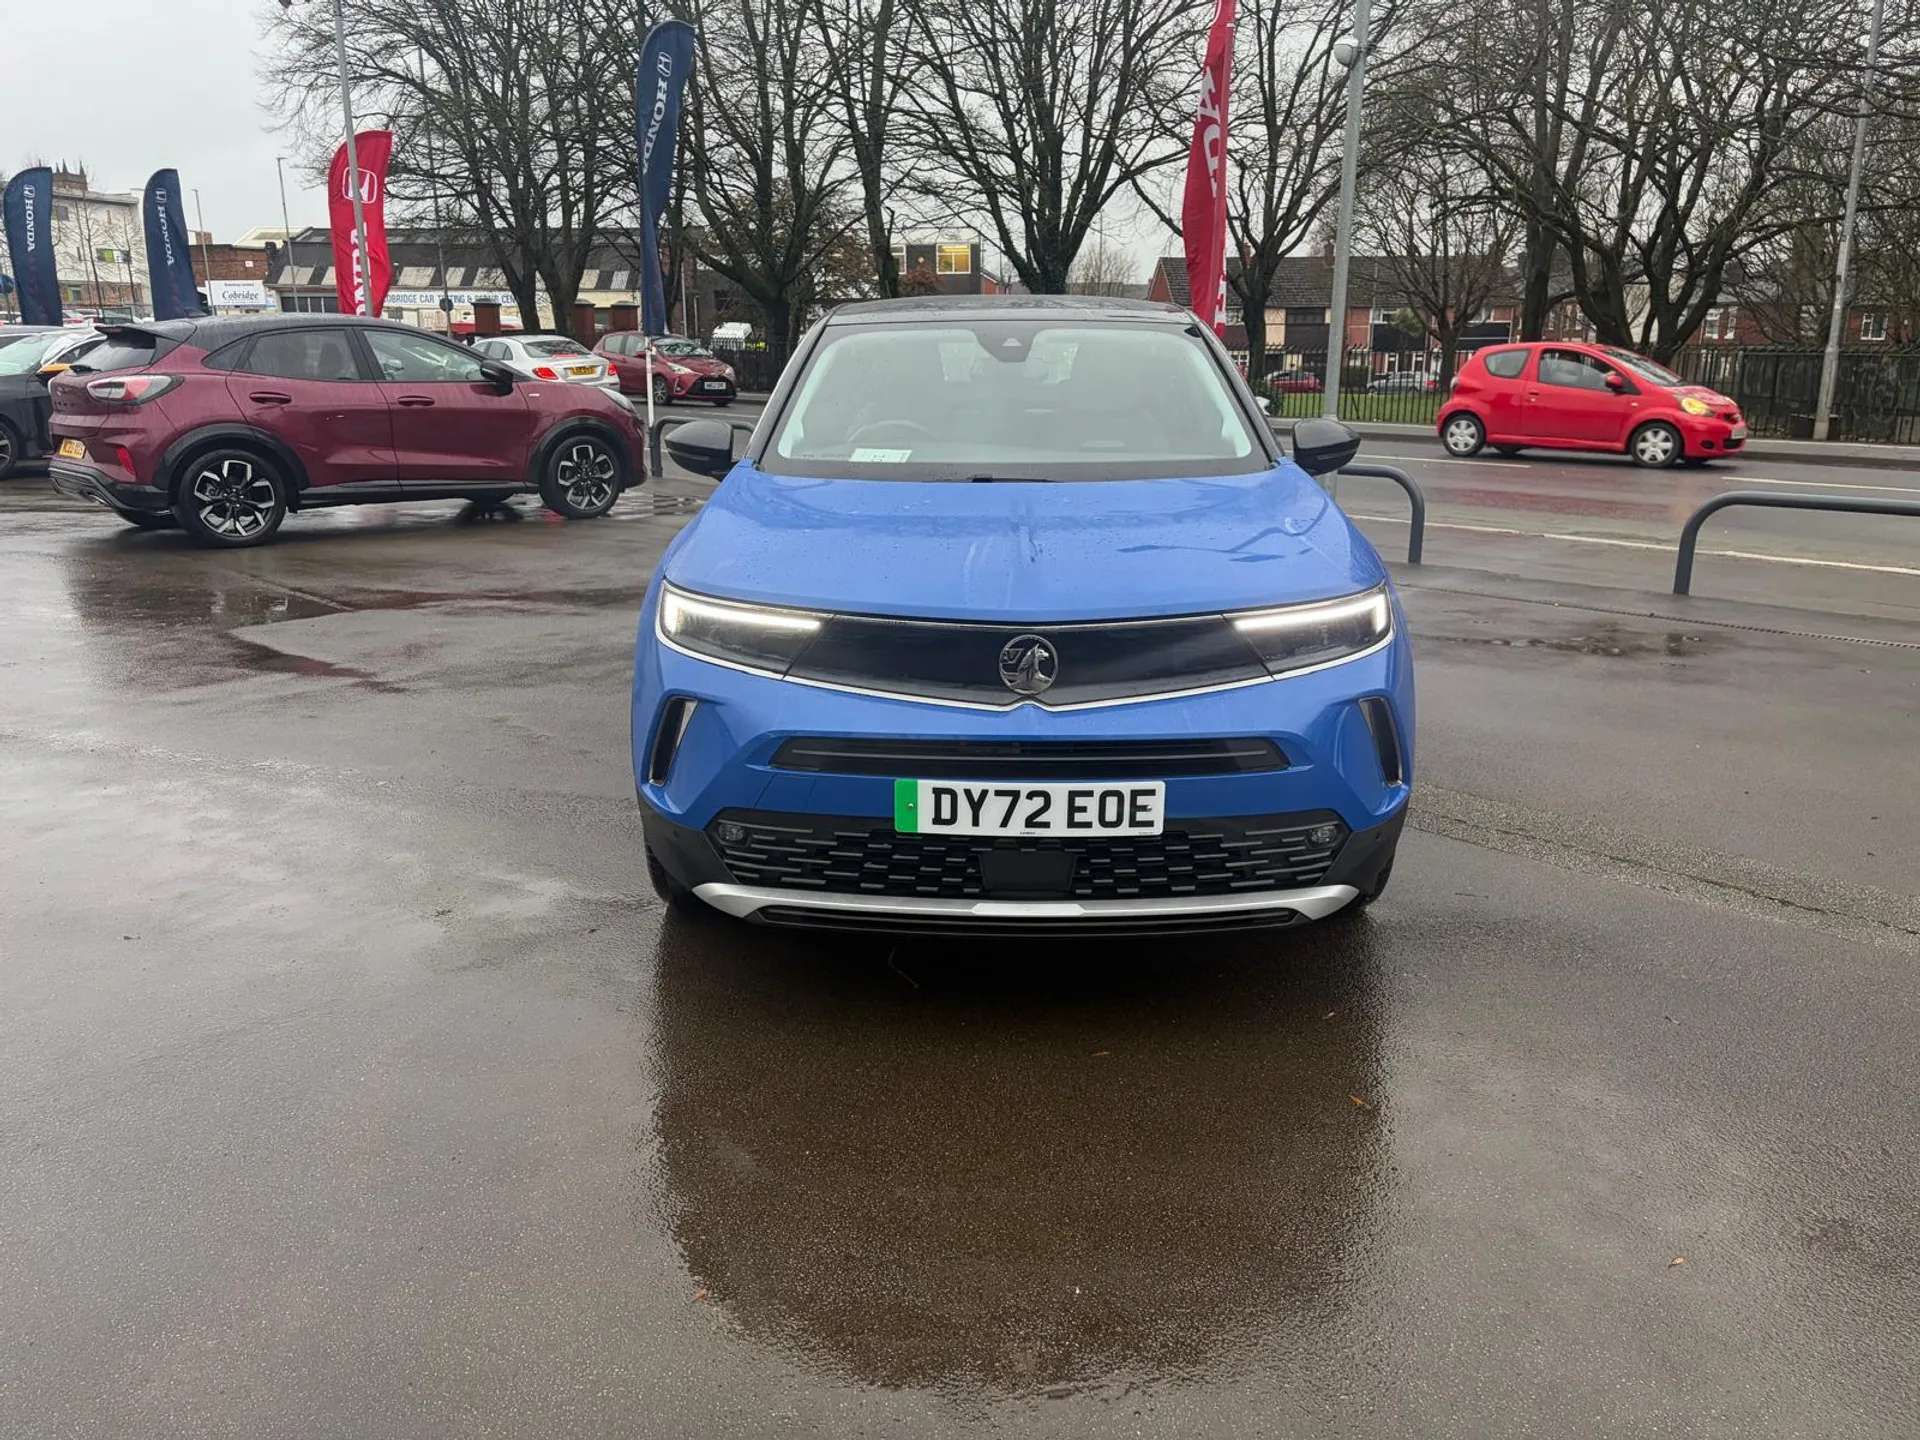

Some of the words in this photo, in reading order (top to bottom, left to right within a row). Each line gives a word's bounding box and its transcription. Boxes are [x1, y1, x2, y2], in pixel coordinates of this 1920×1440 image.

[643, 78, 668, 175] HONDA
[24, 199, 36, 252] HONDA
[157, 205, 175, 266] HONDA
[222, 290, 259, 301] Cobridge
[384, 294, 417, 304] OBRIDGE
[420, 294, 435, 304] CAR
[931, 787, 1051, 829] DY72
[1066, 789, 1157, 829] EOE
